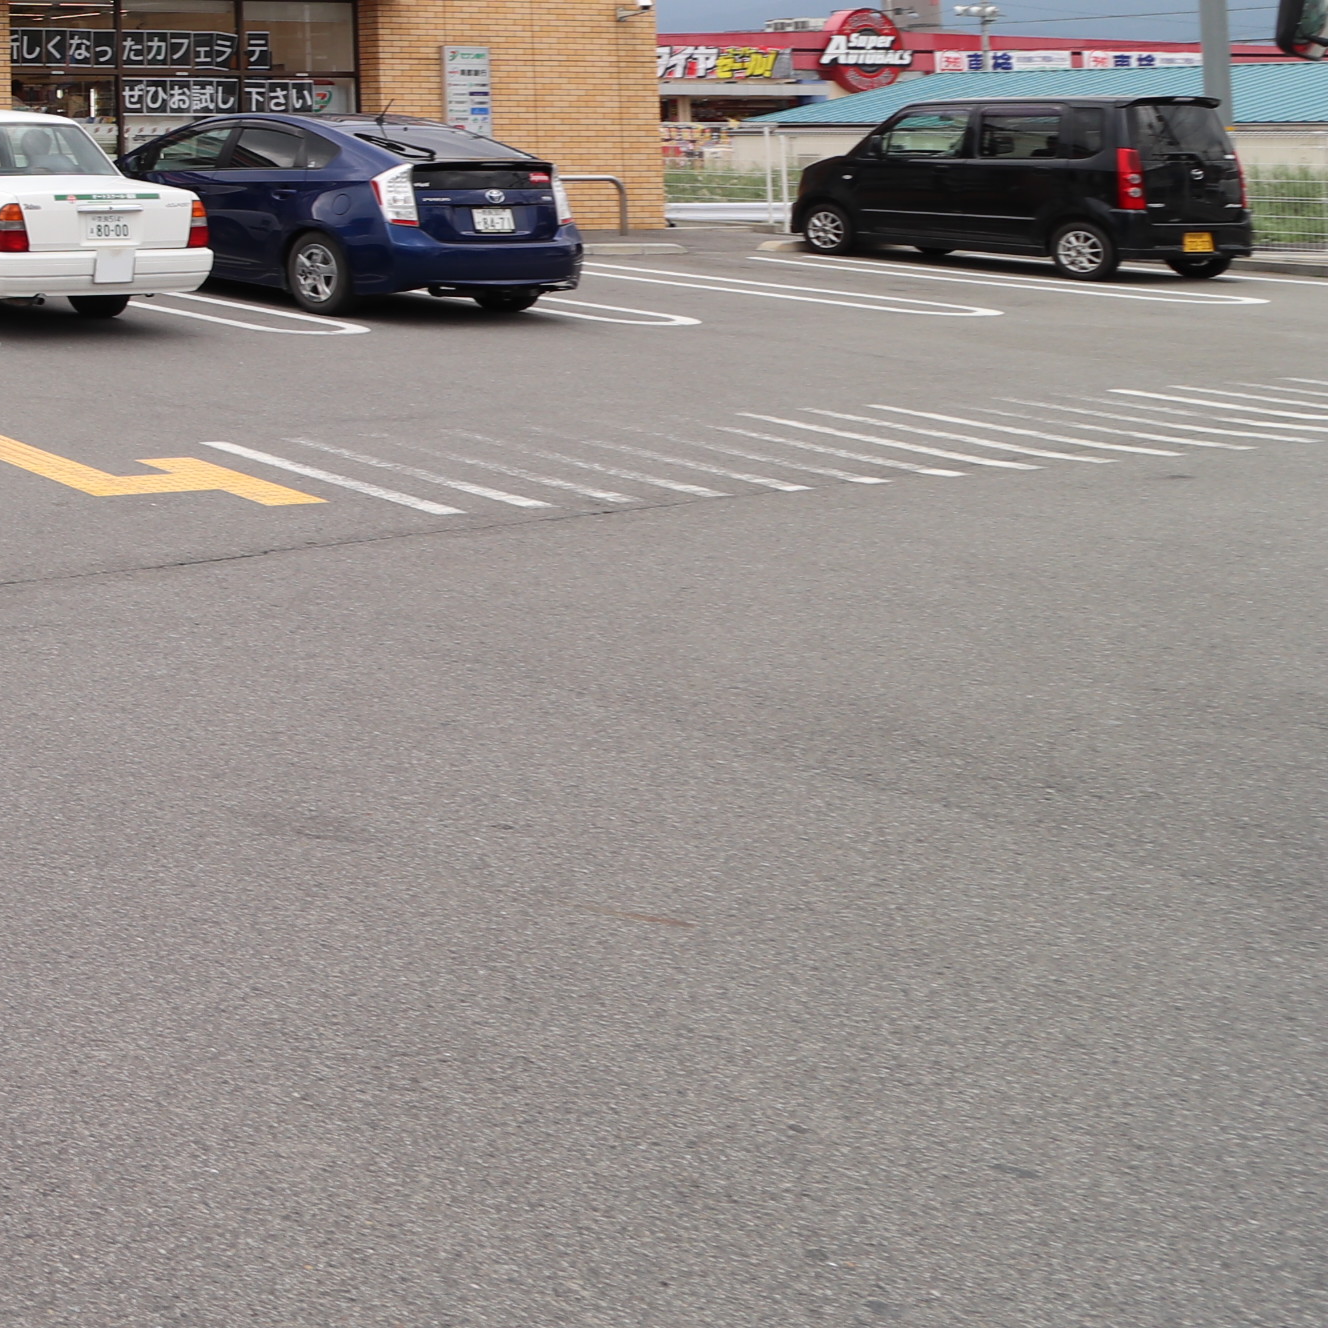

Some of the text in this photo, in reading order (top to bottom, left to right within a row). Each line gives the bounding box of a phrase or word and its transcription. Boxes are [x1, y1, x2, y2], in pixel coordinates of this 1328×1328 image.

[848, 33, 896, 50] Super
[121, 83, 313, 111] ぜひお試し下さい
[96, 224, 129, 237] 80-00
